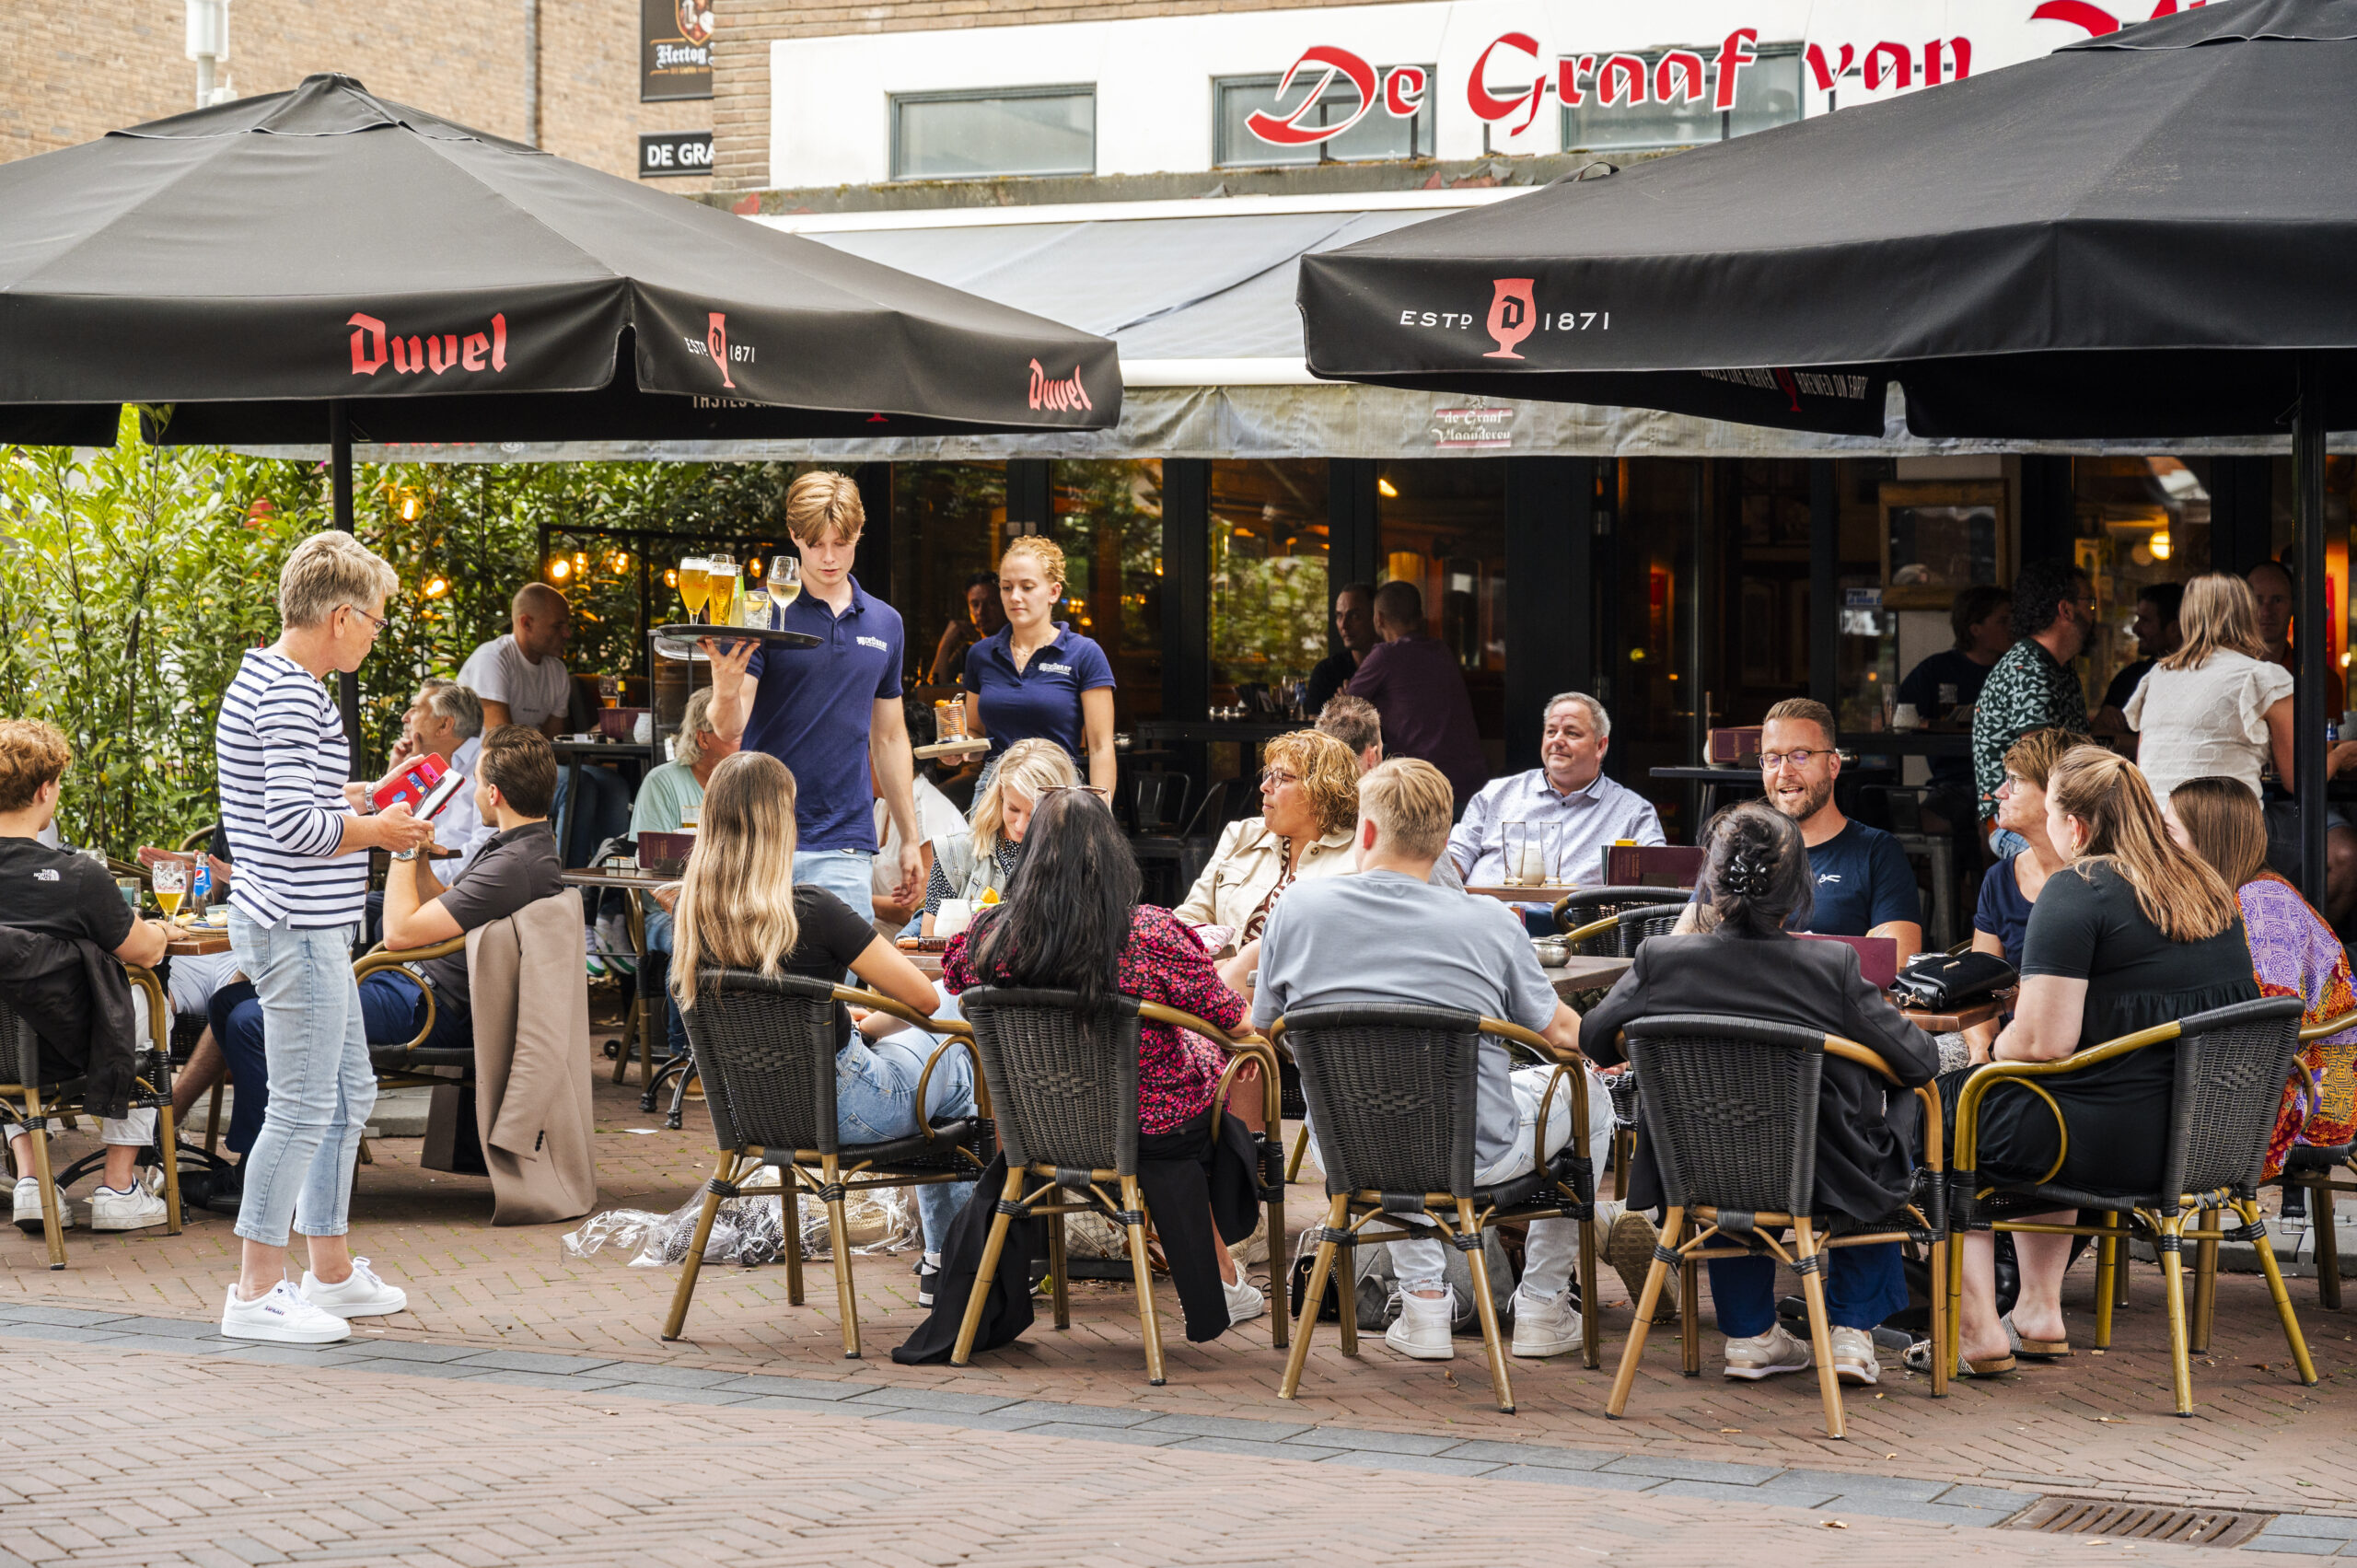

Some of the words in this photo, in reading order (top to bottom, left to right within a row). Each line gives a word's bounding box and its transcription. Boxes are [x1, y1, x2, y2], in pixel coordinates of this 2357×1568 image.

[656, 44, 707, 69] Hertog
[1245, 45, 1426, 146] De
[1468, 27, 1759, 137] Graaf
[1804, 35, 1972, 92] van
[647, 144, 674, 167] DE
[1545, 311, 1609, 331] 1871
[346, 312, 507, 376] Duvel
[730, 344, 755, 363] 1871
[1028, 357, 1093, 412] Duvel
[1794, 372, 1834, 396] BREWED
